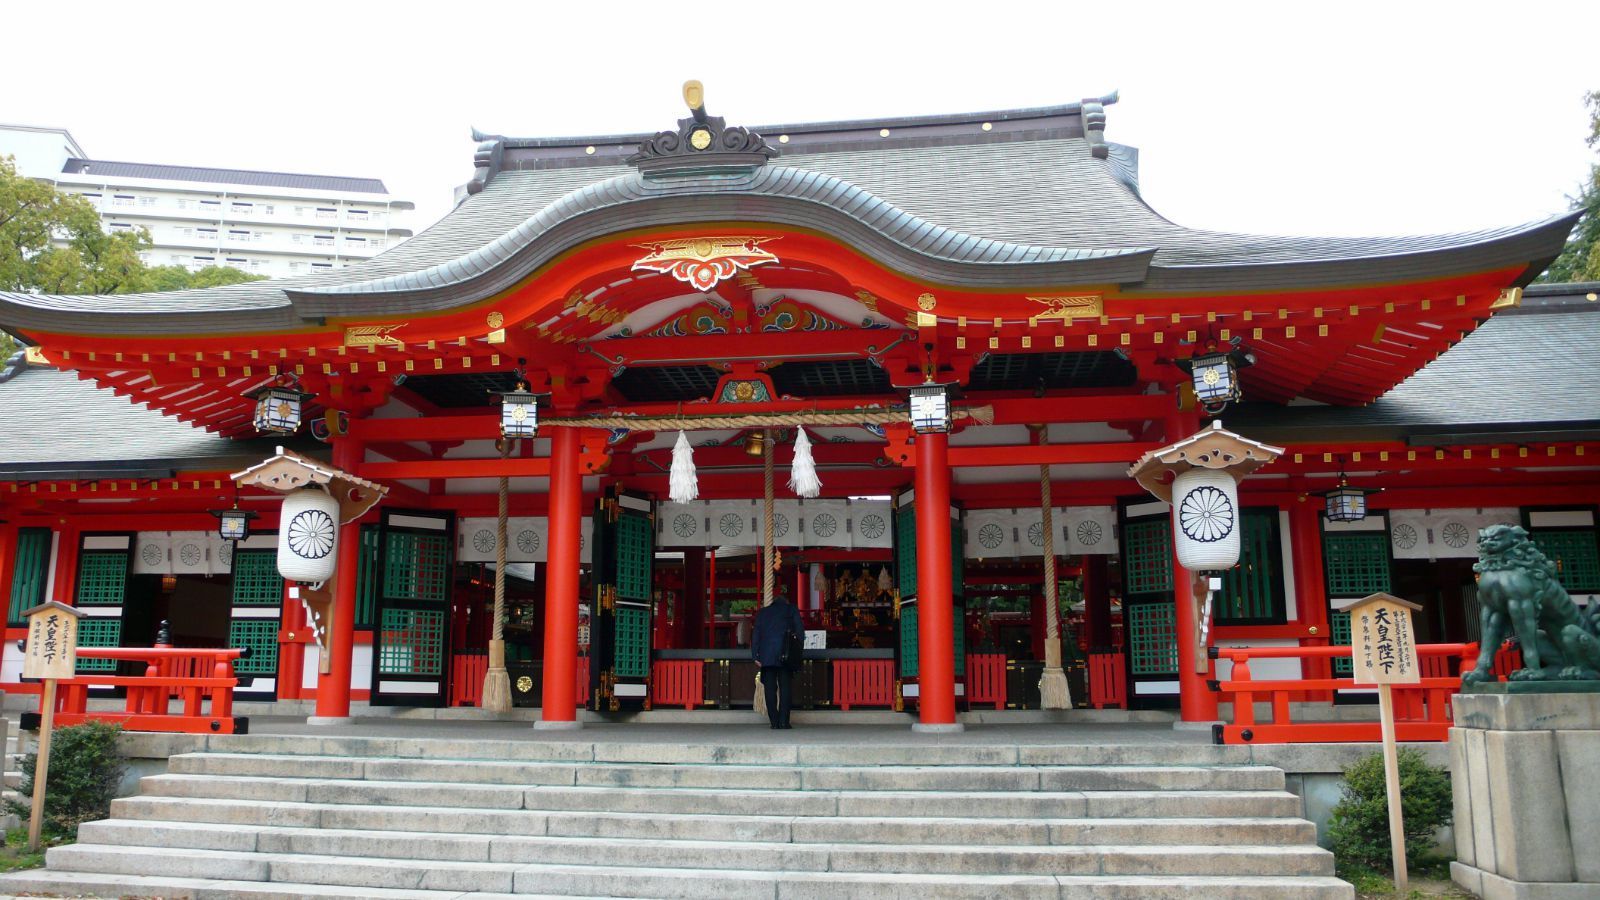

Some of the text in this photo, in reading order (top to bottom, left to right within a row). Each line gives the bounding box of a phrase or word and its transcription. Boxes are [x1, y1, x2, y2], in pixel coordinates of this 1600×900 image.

[44, 615, 58, 664] 天皇陛下
[1375, 608, 1394, 674] 天皇陛下
